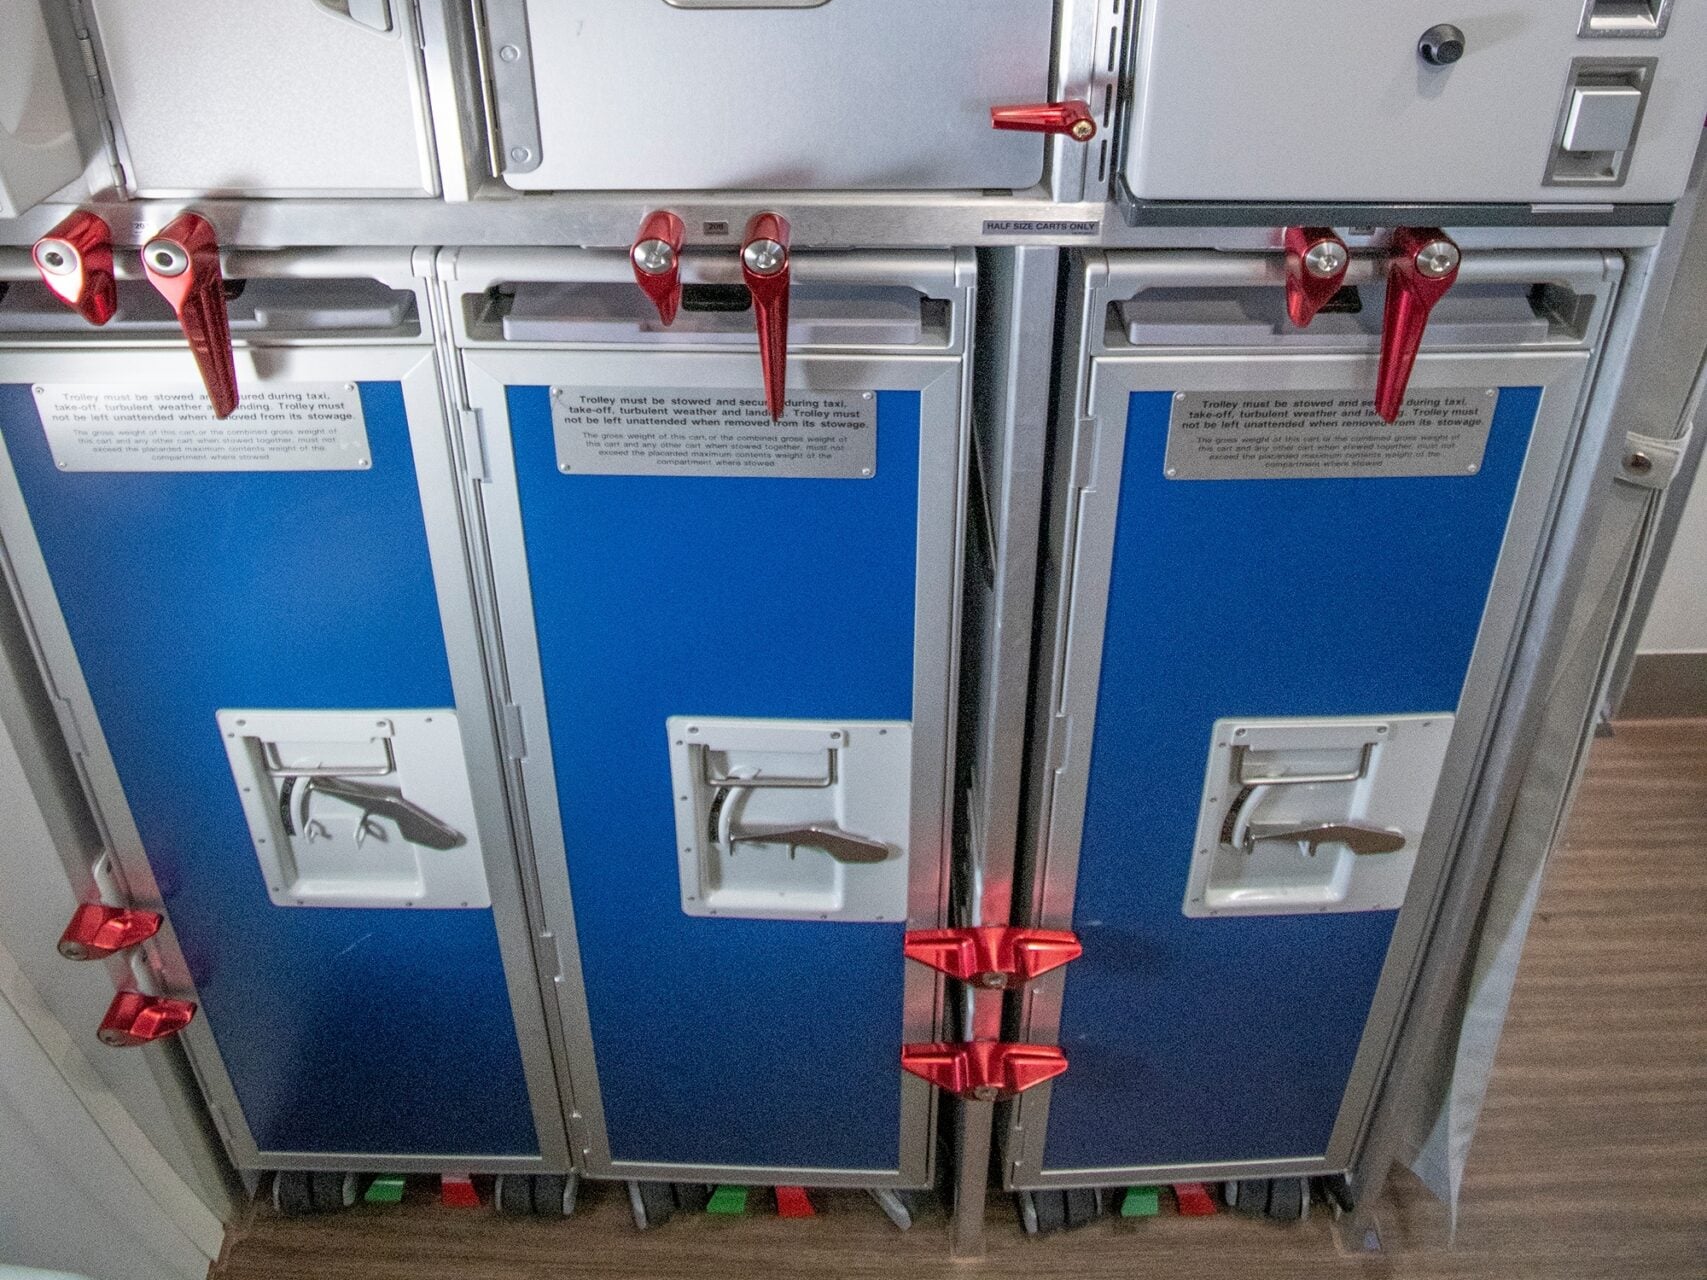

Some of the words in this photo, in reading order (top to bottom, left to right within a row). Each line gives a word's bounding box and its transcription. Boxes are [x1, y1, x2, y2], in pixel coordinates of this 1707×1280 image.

[987, 222, 1010, 230] HALF
[63, 393, 98, 402] Trolley
[154, 393, 194, 401] stowed
[268, 392, 302, 402] during
[306, 392, 330, 401] taxi,
[580, 396, 616, 406] Trolley
[620, 397, 647, 405] must
[652, 397, 665, 405] be
[671, 398, 711, 406] stowed
[716, 398, 736, 406] and
[784, 400, 819, 408] during
[823, 400, 847, 408] taxi,
[105, 403, 153, 411] turbulent
[159, 403, 202, 411] weather
[279, 402, 314, 411] Trolley
[1202, 400, 1238, 410] Trolley
[1243, 400, 1270, 408] must
[1274, 400, 1288, 408] be
[1293, 399, 1334, 408] stowed
[1338, 399, 1358, 407] and
[1406, 398, 1441, 408] during
[74, 413, 87, 421] be
[91, 413, 109, 421] left
[113, 413, 174, 421] unattended
[179, 413, 207, 421] when
[308, 413, 355, 421] stowage.
[569, 406, 615, 415] take-off,
[619, 407, 668, 415] turbulent
[673, 408, 717, 416] weather
[721, 408, 741, 416] and
[794, 409, 829, 419] Trolley
[1189, 411, 1235, 419] take-off,
[1240, 410, 1289, 418] turbulent
[1293, 409, 1338, 418] weather
[1341, 409, 1361, 417] and
[1413, 408, 1449, 417] Trolley
[1451, 408, 1479, 416] must
[586, 416, 599, 424] be
[603, 416, 622, 424] left
[626, 417, 687, 425] unattended
[691, 418, 720, 426] when
[820, 422, 869, 430] stowage.
[1182, 421, 1200, 429] not
[1203, 421, 1217, 429] be
[1221, 420, 1239, 429] left
[1243, 420, 1305, 429] unattended
[1309, 420, 1339, 428] when
[627, 433, 655, 441] weight
[807, 436, 836, 444] weight
